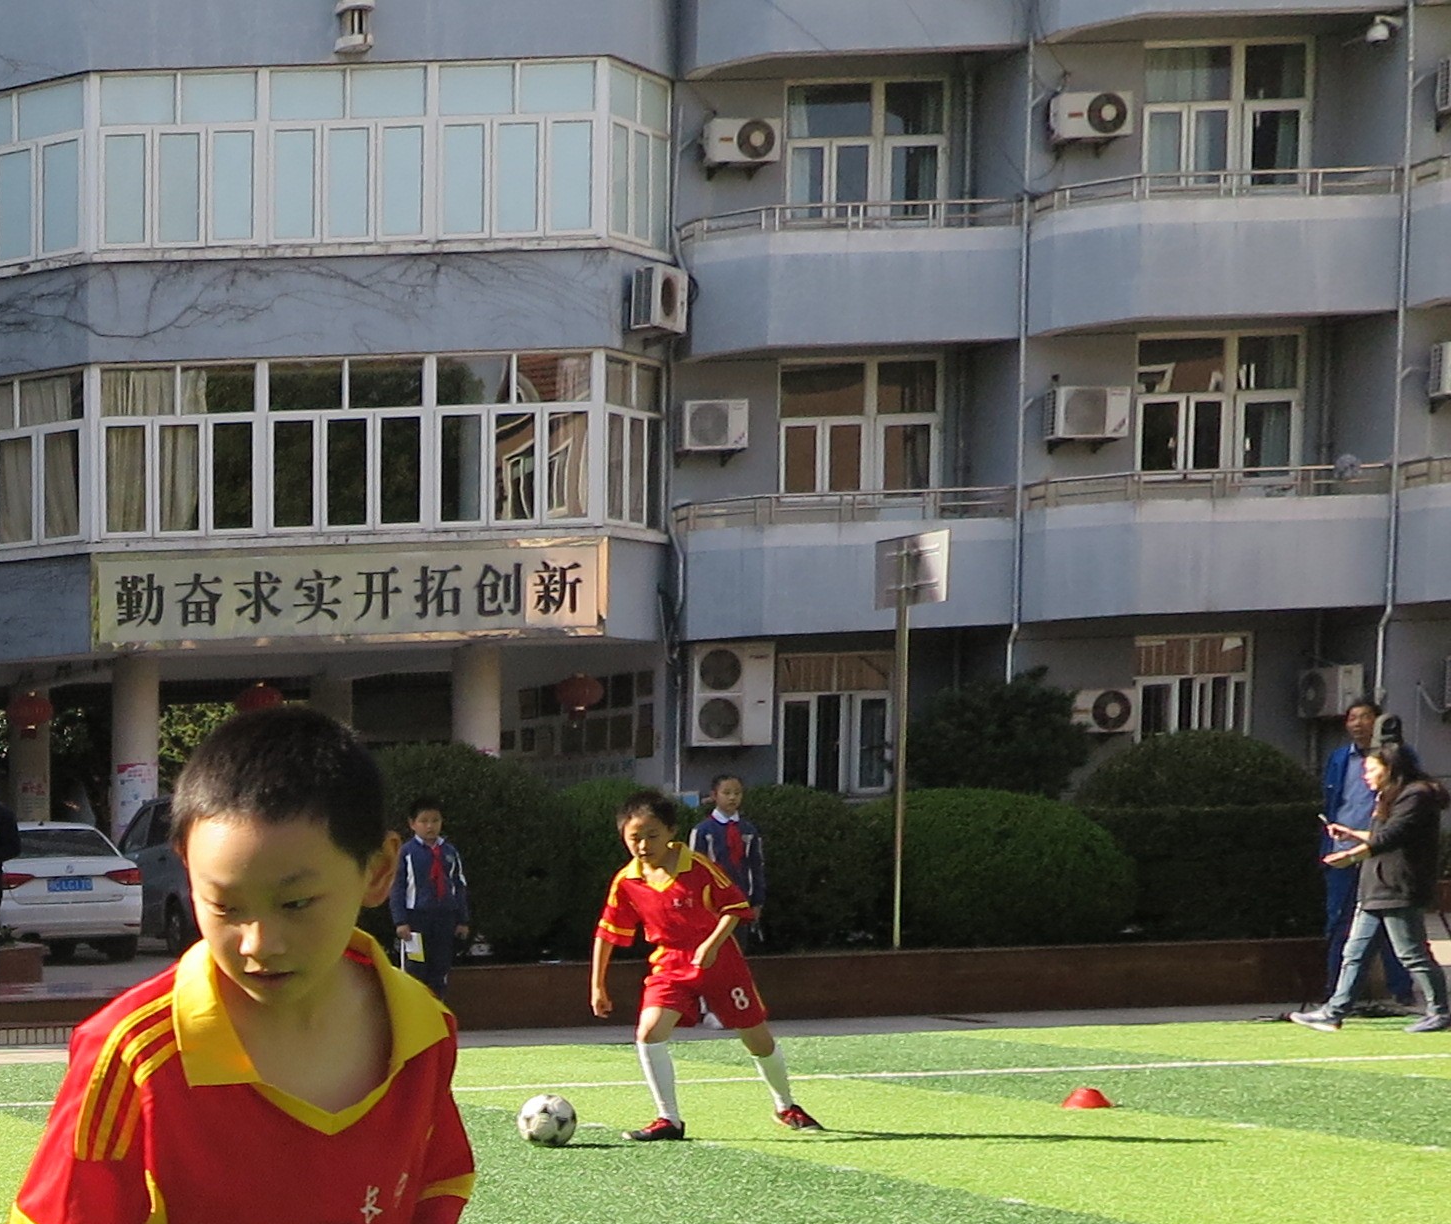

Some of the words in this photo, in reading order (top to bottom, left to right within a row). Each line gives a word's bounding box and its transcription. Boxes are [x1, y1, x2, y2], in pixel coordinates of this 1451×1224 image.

[114, 560, 583, 629] 勤奋求实开拓创新
[731, 986, 749, 1010] 8
